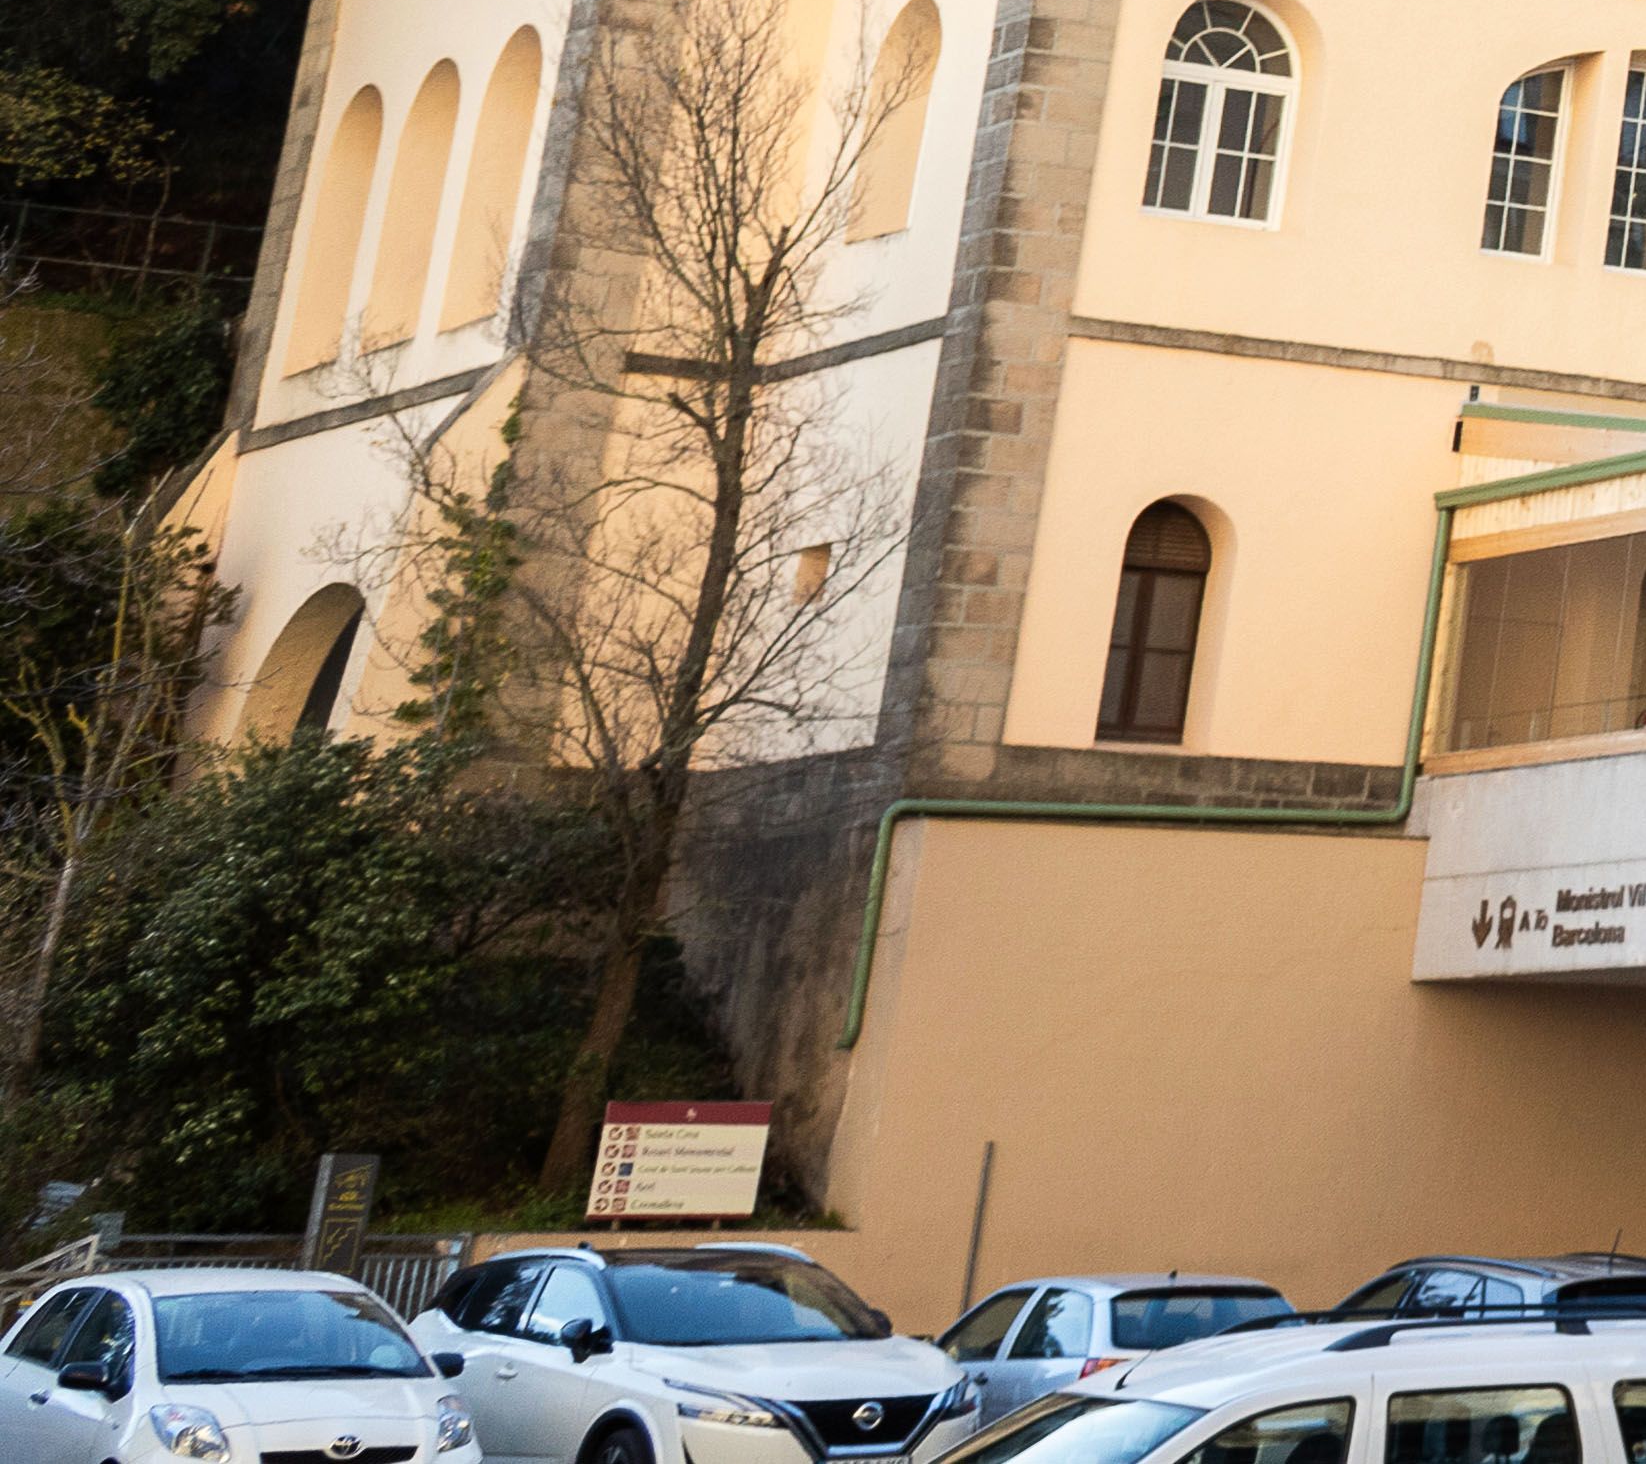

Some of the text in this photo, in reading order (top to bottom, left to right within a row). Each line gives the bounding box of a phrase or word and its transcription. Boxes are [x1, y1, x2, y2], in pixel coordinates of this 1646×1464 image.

[1518, 910, 1531, 932] A
[1534, 909, 1549, 931] To
[1556, 885, 1625, 913] Monistrol
[1552, 922, 1625, 948] Barcelona
